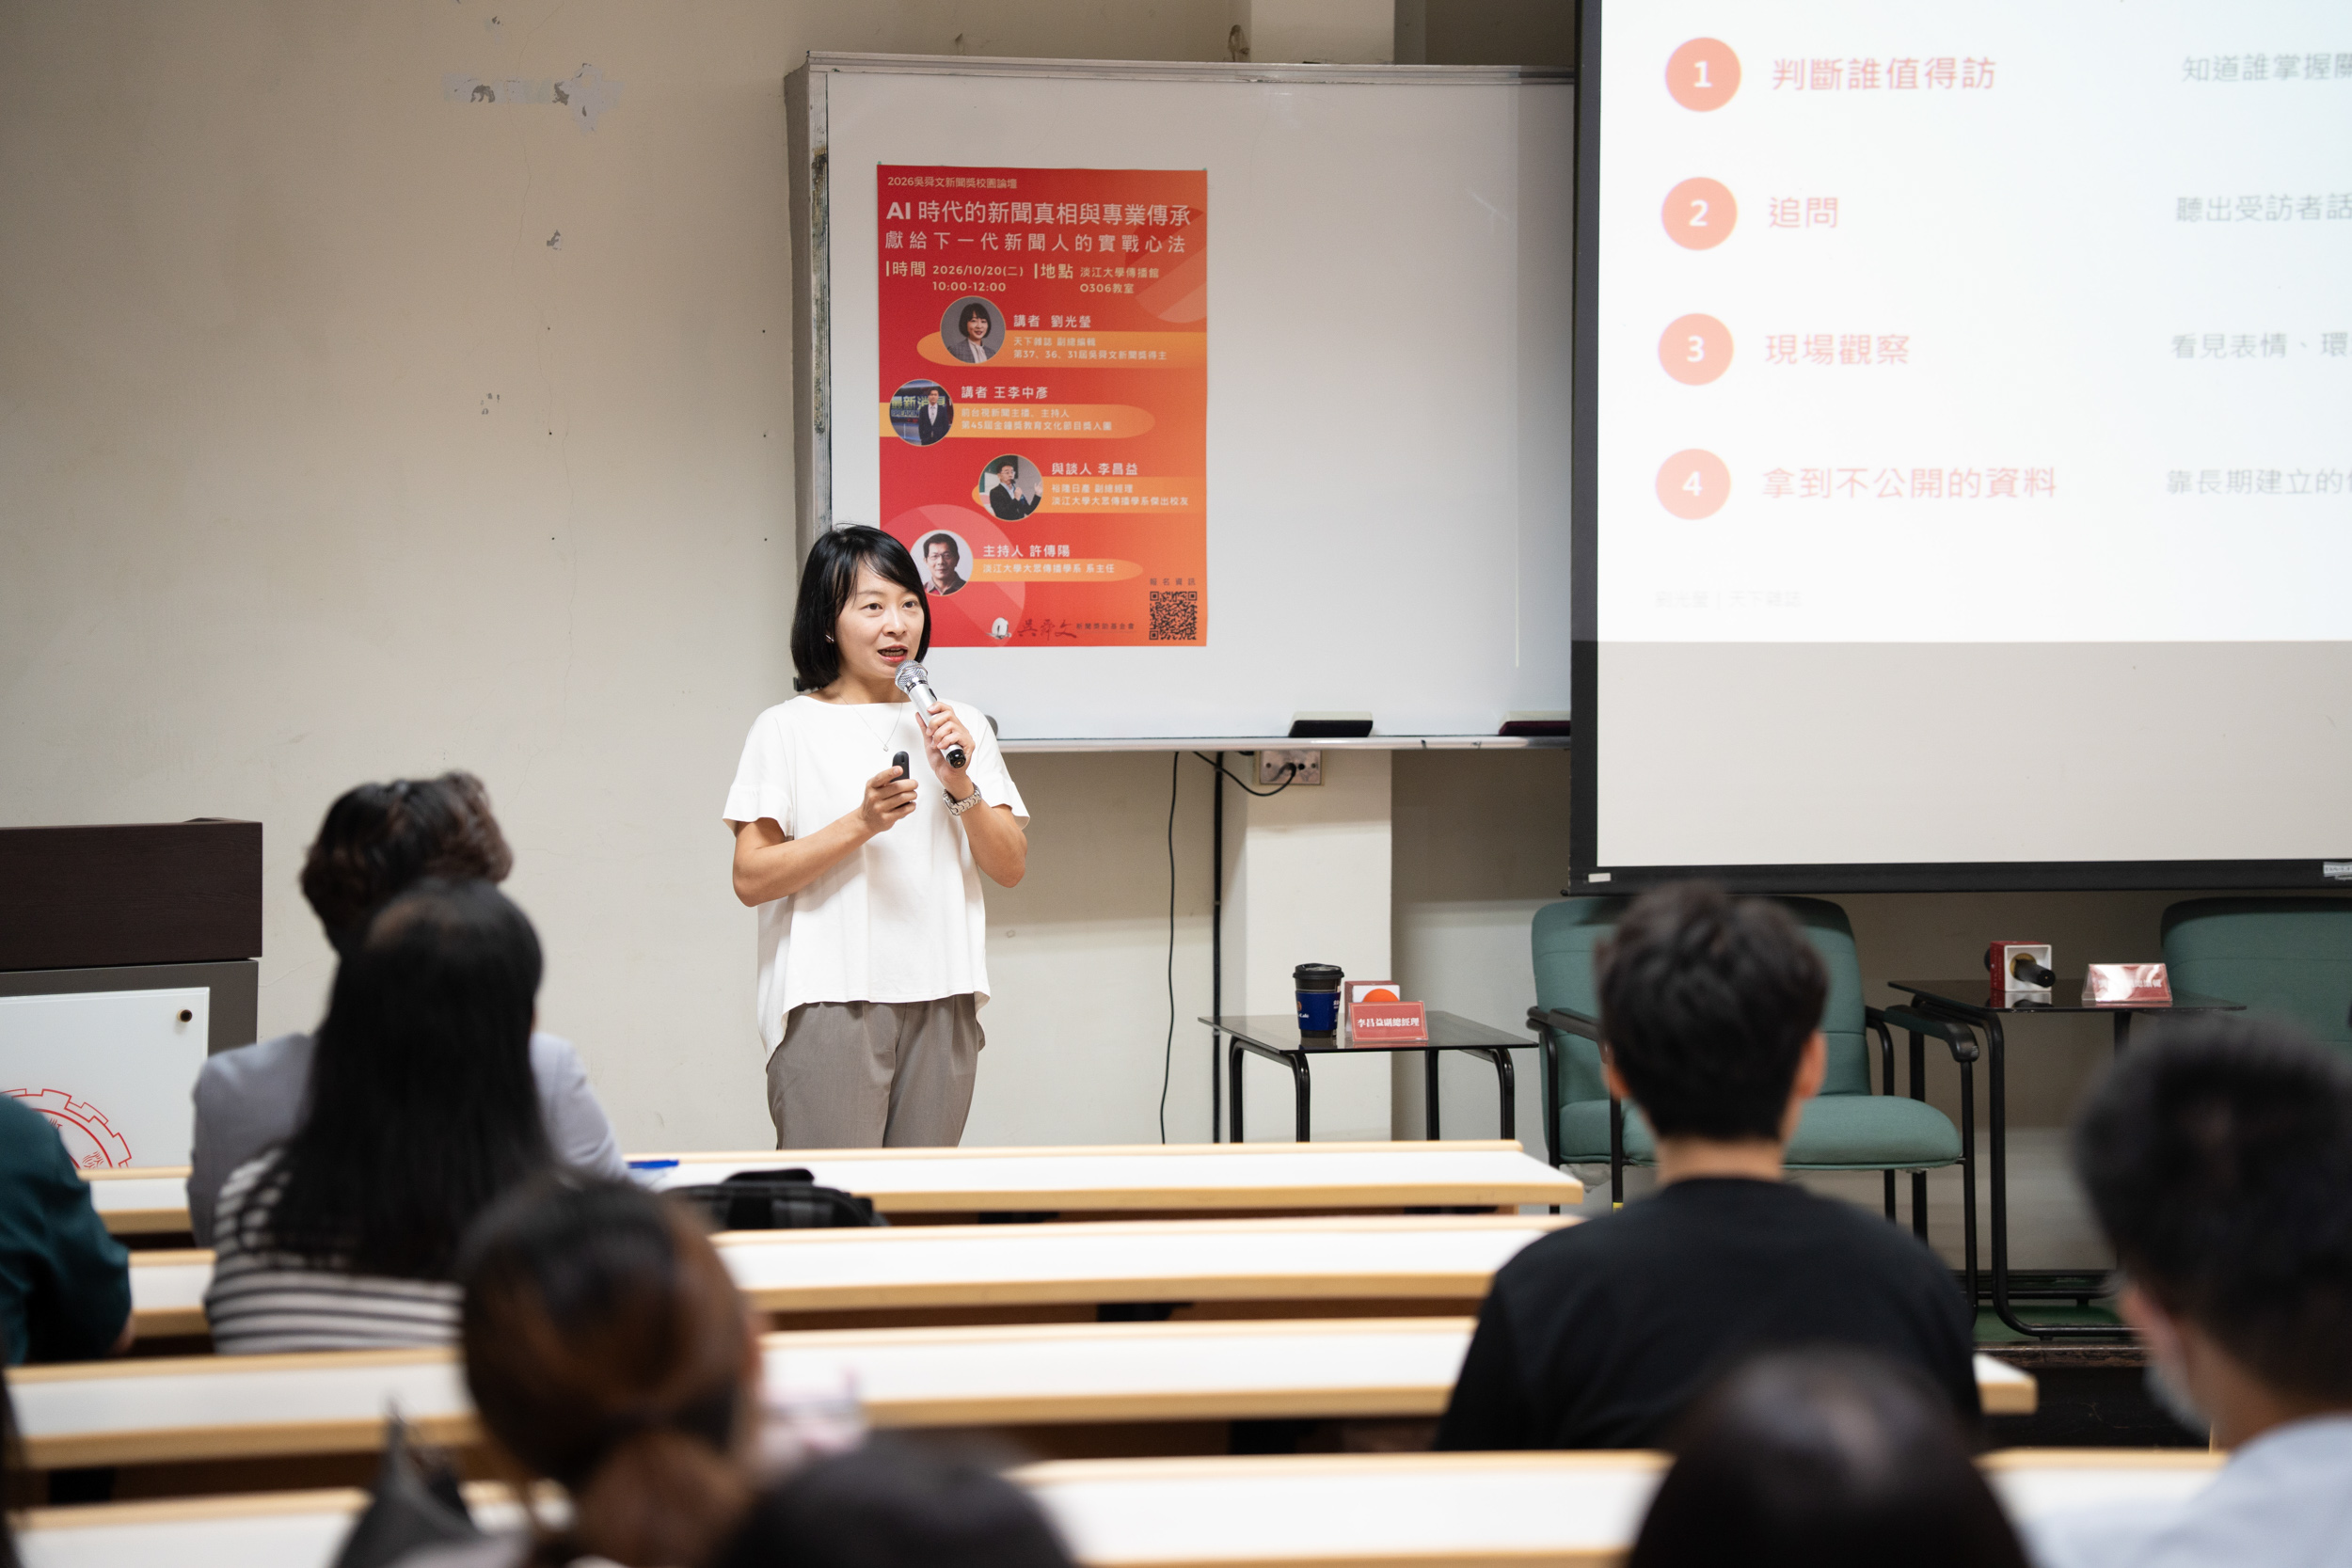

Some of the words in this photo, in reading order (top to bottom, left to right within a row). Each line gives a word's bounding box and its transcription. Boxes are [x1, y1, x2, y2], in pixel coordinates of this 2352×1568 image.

[1693, 60, 1711, 88] 1
[1772, 56, 1997, 91] 判斷誰值得訪
[886, 201, 911, 220] AI
[918, 200, 1191, 227] 時代的新聞真相與專業傳承
[1689, 200, 1708, 227] 2
[1768, 197, 1839, 230] 追問
[2175, 193, 2352, 223] 聽出受訪者話
[884, 230, 1185, 254] 獻給下一代新聞人的實戰心法
[892, 261, 926, 277] 時間
[932, 264, 1024, 277] 2026/10/20(二)
[1041, 263, 1073, 279] 地點
[1080, 267, 1159, 278] 淡江大學傳播館
[932, 281, 1007, 293] 10:00-12:00
[1013, 314, 1041, 328] 講者
[1051, 314, 1091, 328] 劉光瑩
[1013, 337, 1053, 346] 天下雜誌
[1686, 337, 1706, 363] 3
[1764, 333, 1910, 366] 現場觀察
[2170, 331, 2352, 359] 看見表情、環
[961, 386, 988, 399] 講者
[993, 386, 1049, 400] 王李中彥
[1051, 463, 1092, 475] 與談人
[1098, 463, 1138, 476] 李昌益
[1682, 471, 1703, 498] 4
[1762, 467, 2057, 499] 拿到不公開的資料
[2166, 467, 2352, 496] 靠長期建立的
[983, 545, 1024, 557] 主持人
[1029, 545, 1071, 557] 許傳陽
[1086, 563, 1115, 574] 系主任
[1357, 1017, 1420, 1028] 李昌益副總經理
